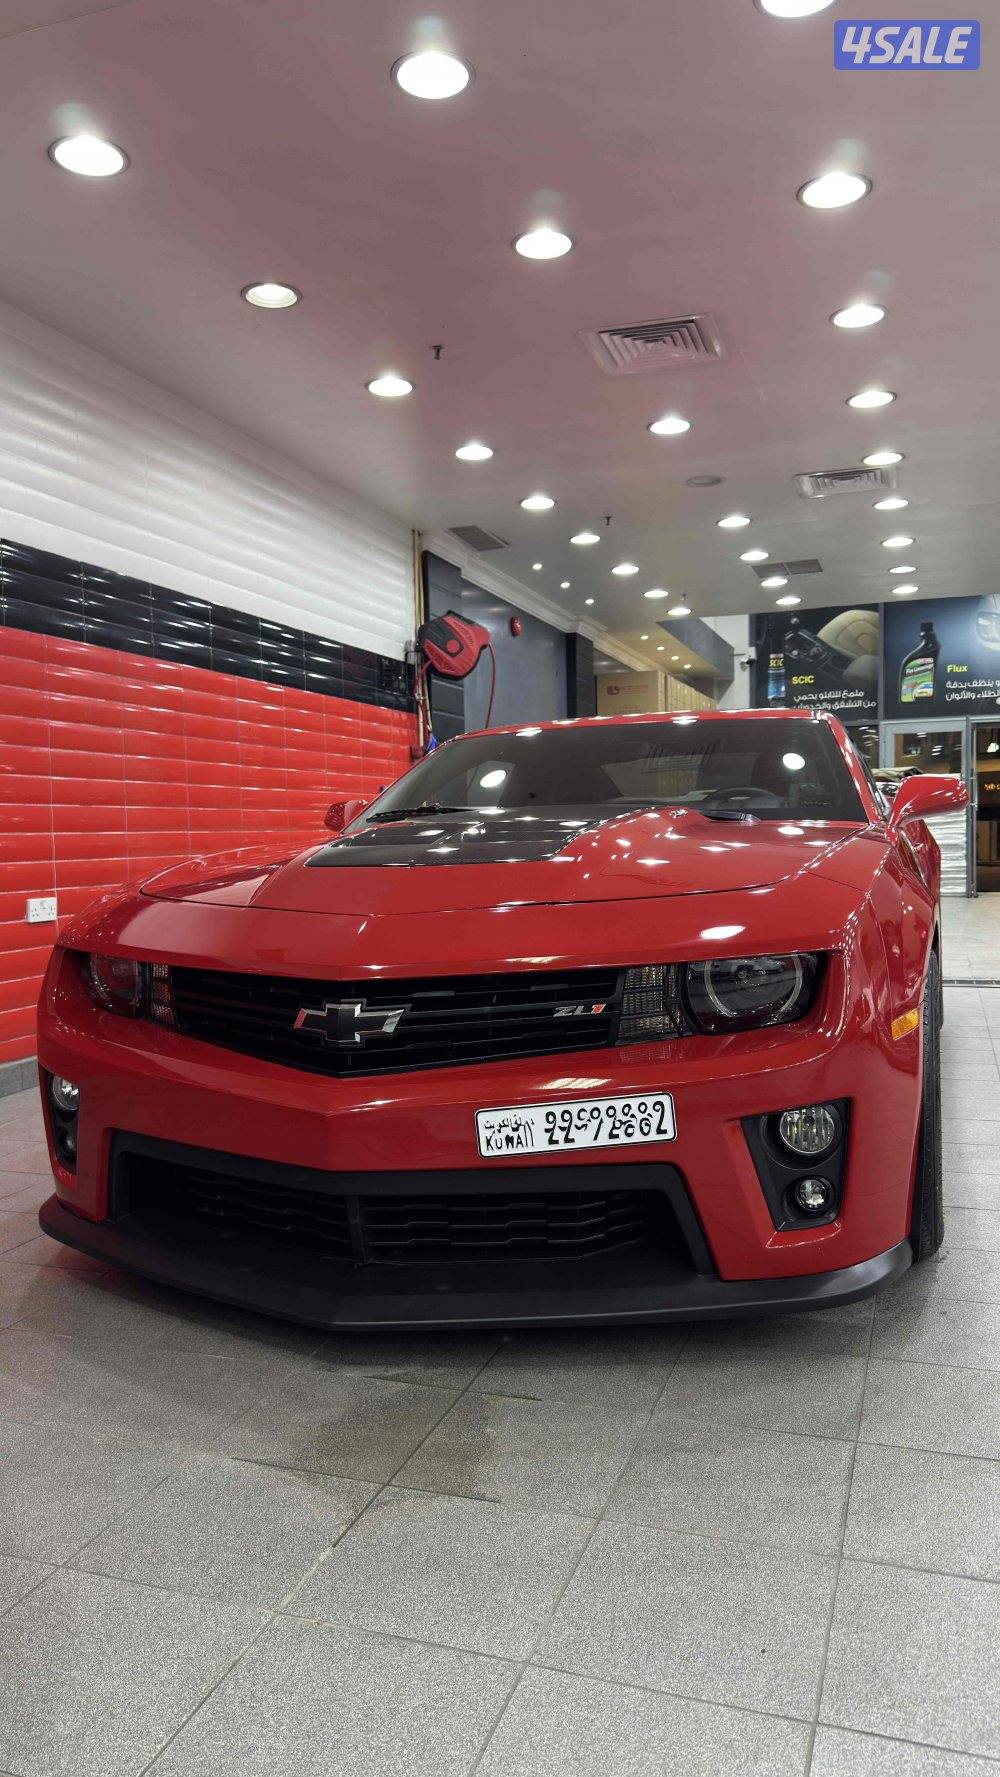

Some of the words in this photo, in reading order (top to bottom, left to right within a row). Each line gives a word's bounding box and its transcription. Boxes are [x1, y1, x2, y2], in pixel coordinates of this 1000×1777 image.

[947, 664, 968, 673] Flux
[792, 675, 815, 685] SCIC
[793, 694, 817, 703] يحمي
[842, 689, 864, 699] ملمع
[832, 700, 862, 710] التشقق
[863, 701, 877, 709] من
[552, 1003, 608, 1018] ZL1
